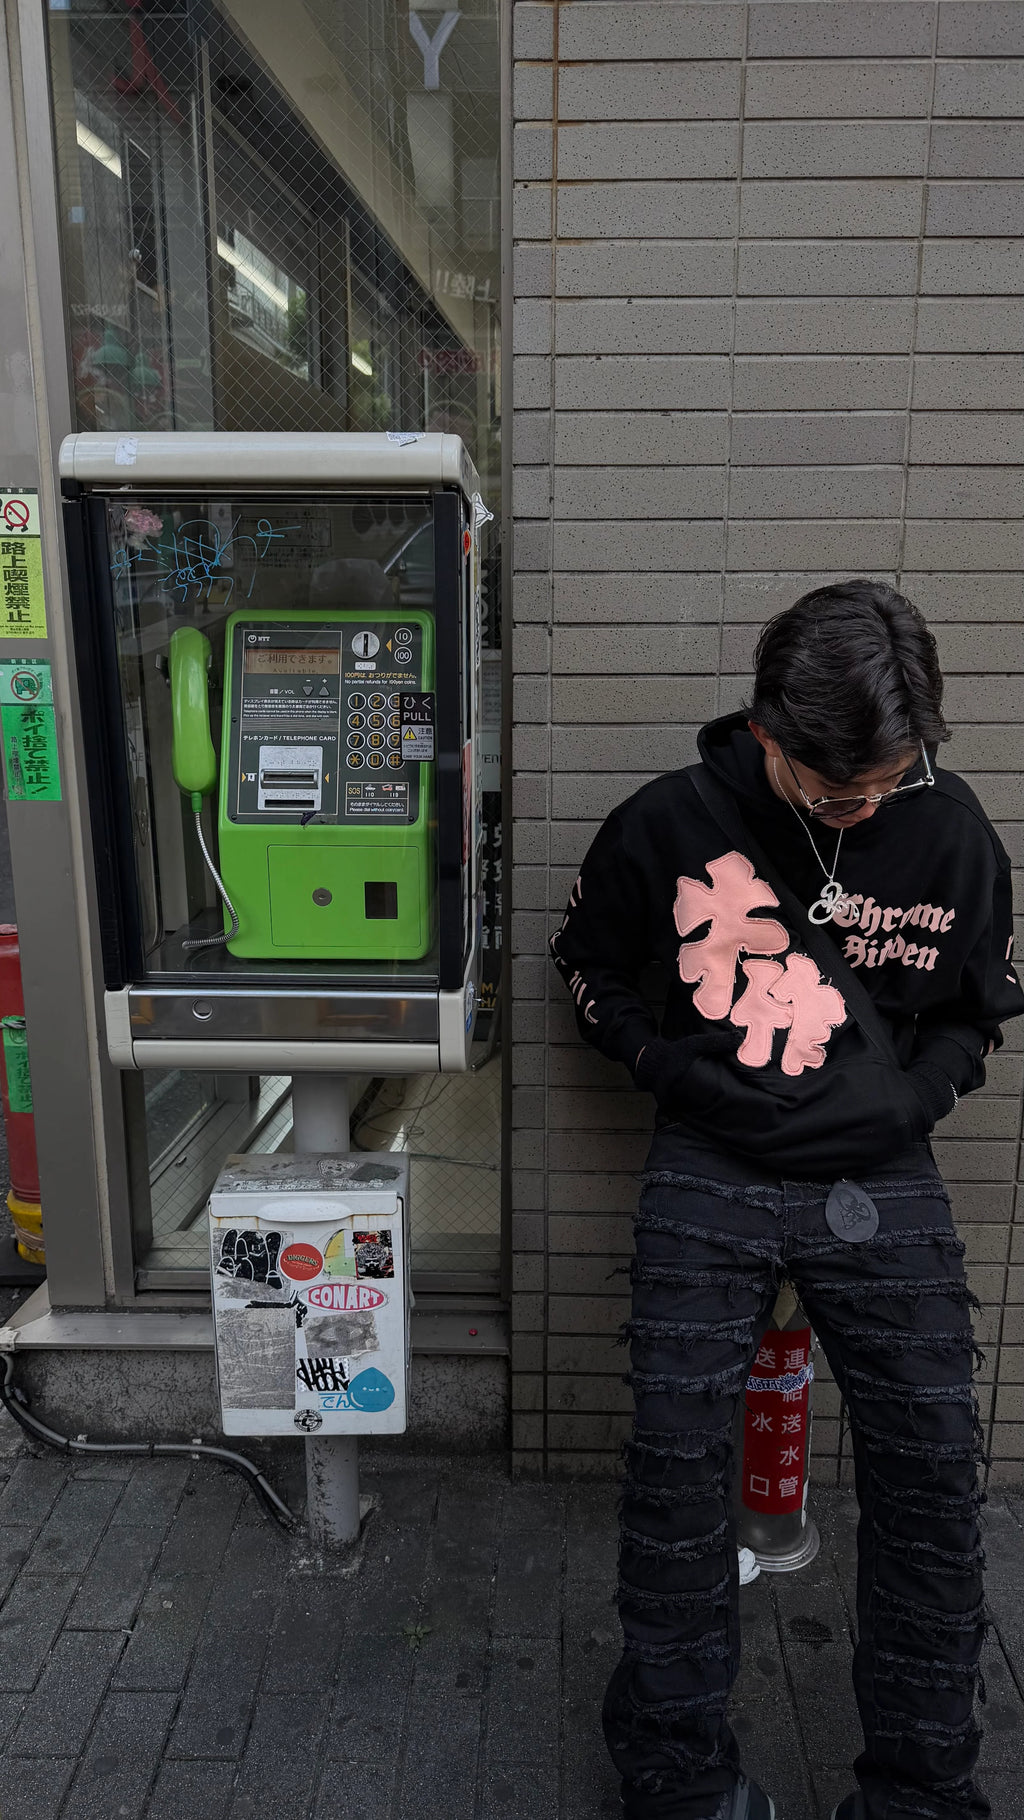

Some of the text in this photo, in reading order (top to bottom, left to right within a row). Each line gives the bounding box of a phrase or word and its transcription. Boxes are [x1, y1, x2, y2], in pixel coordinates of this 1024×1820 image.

[1, 542, 31, 622] 路上喫煙禁止
[258, 653, 333, 664] ご利用できます。
[397, 652, 410, 660] 100
[373, 695, 380, 708] 2
[403, 696, 431, 709] ひく
[351, 715, 400, 727] 4 5 6
[403, 712, 431, 721] PULL
[352, 734, 400, 747] 7 8 9
[370, 754, 380, 766] 0
[348, 787, 361, 795] SOS
[309, 1286, 381, 1310] CONART
